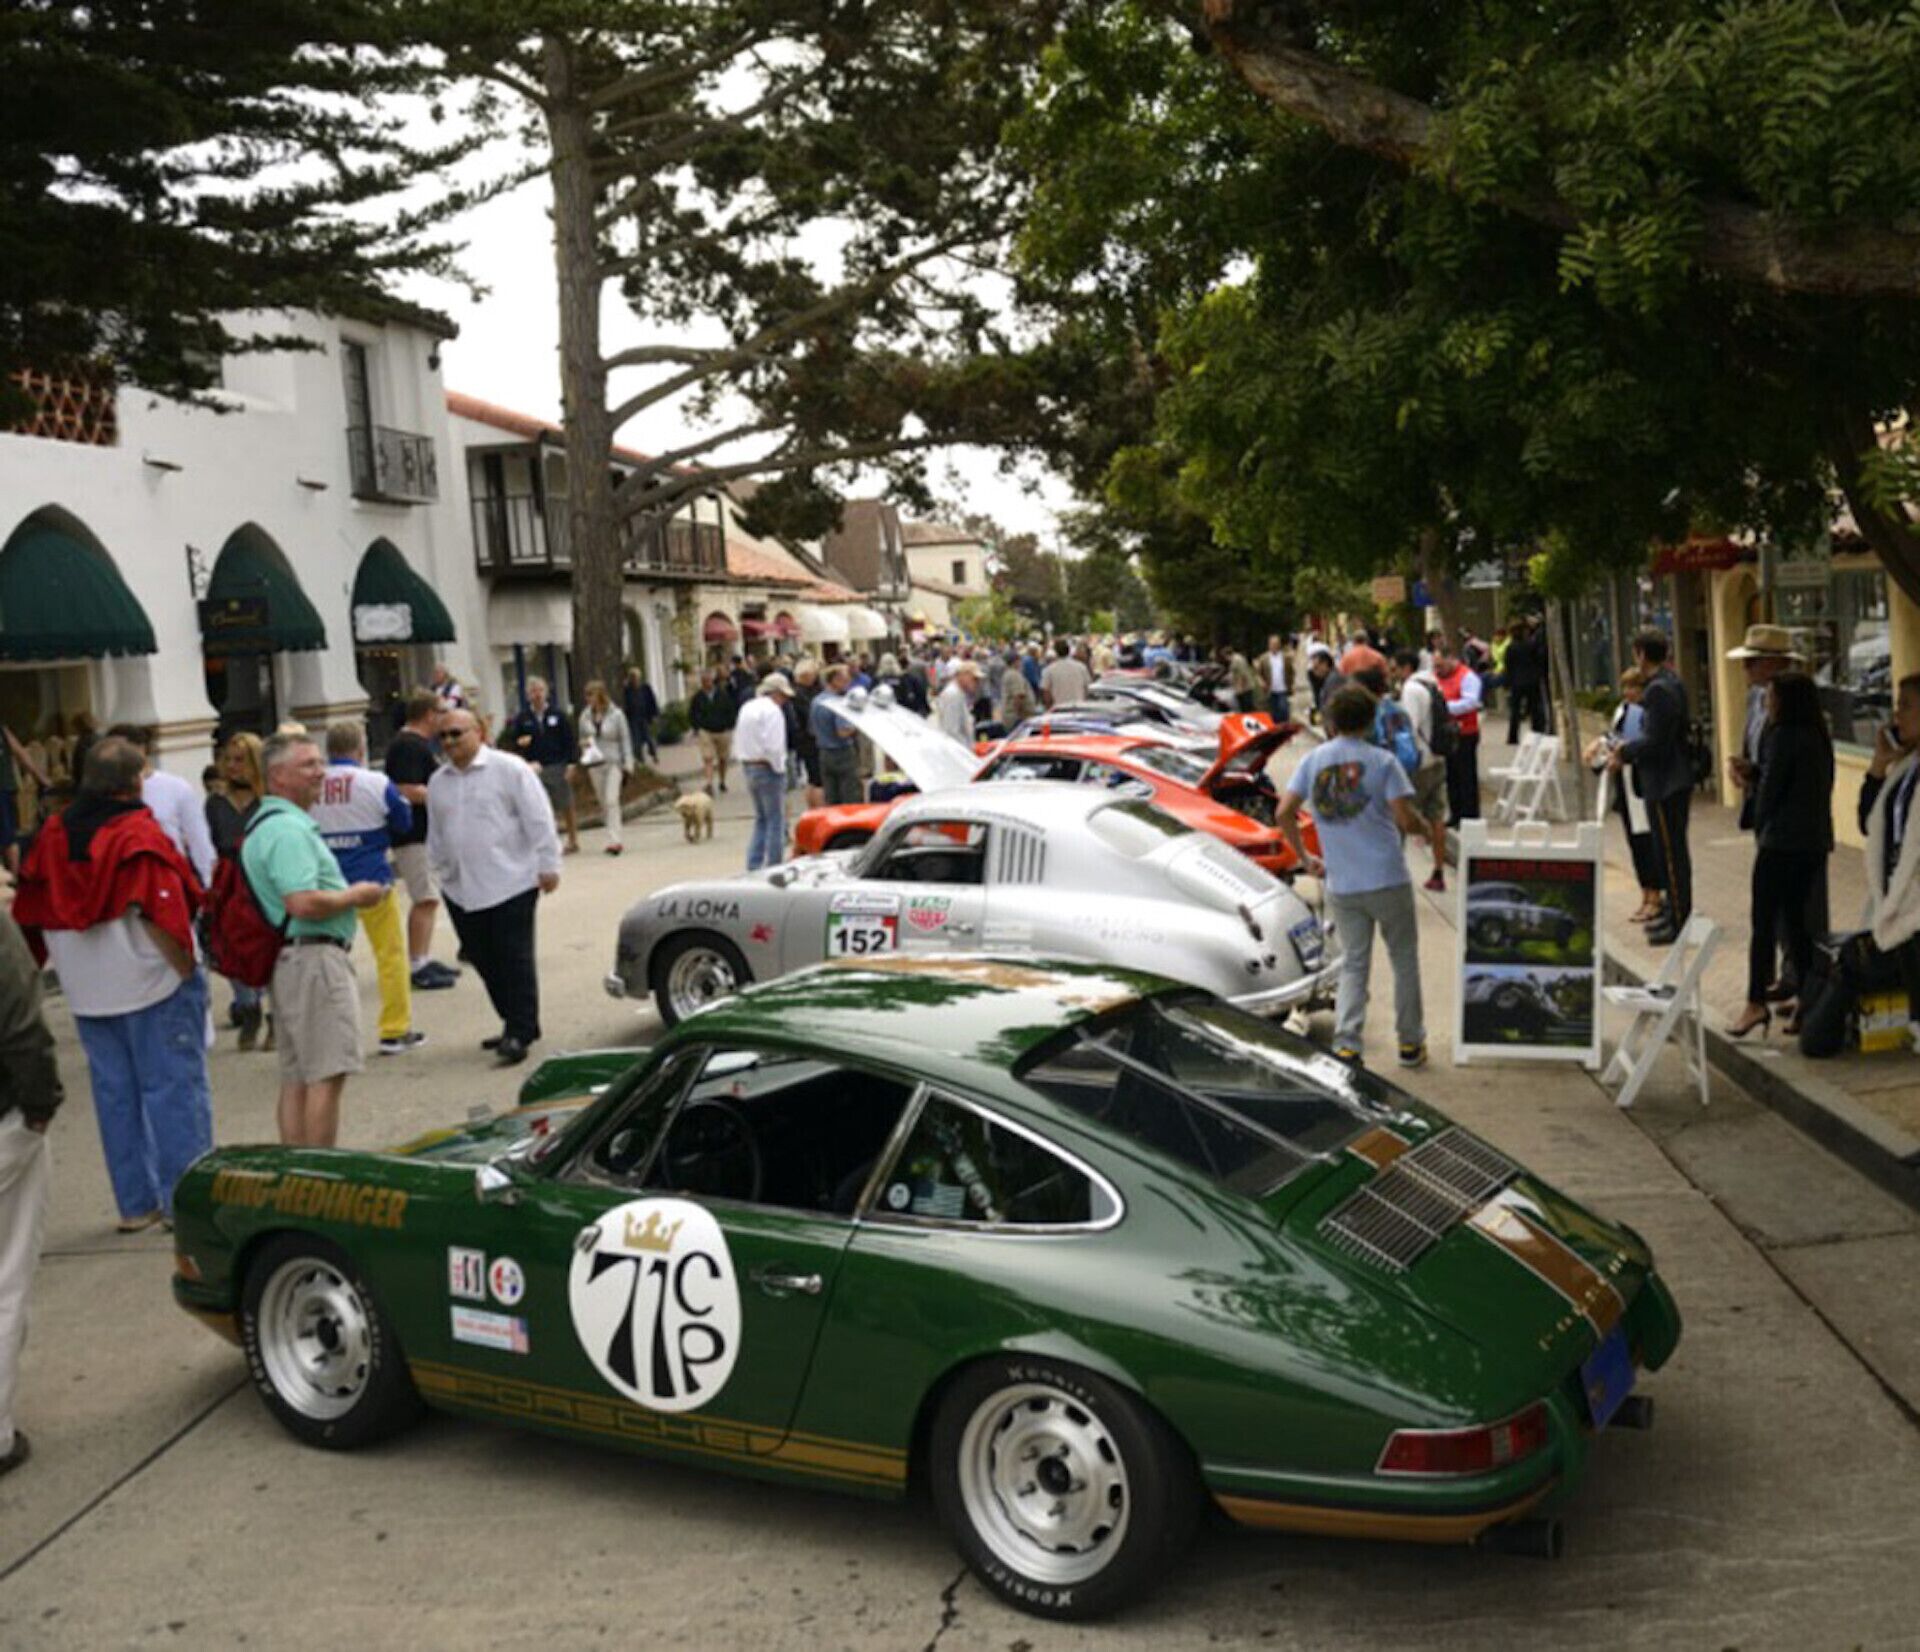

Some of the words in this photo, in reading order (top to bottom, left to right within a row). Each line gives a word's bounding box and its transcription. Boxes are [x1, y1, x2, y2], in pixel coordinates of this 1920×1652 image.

[657, 900, 677, 918] LA
[686, 898, 739, 921] LOMA
[835, 927, 887, 954] 152
